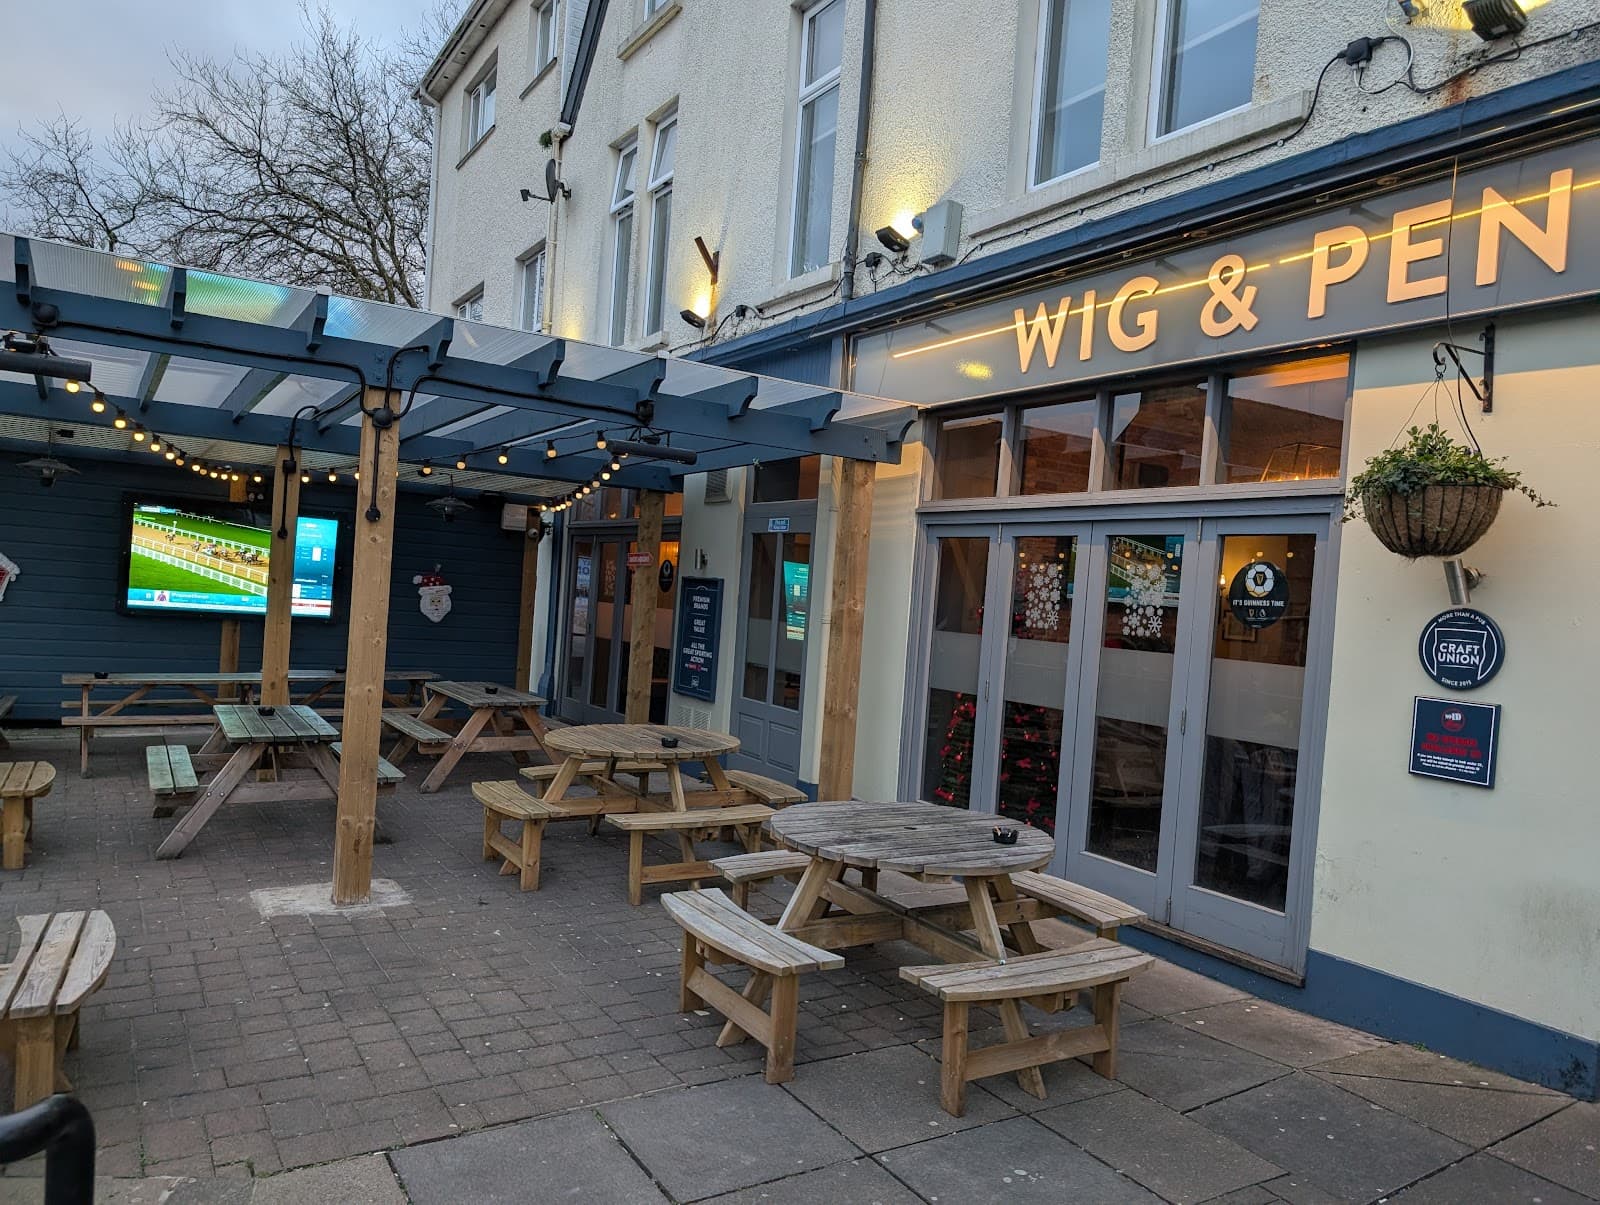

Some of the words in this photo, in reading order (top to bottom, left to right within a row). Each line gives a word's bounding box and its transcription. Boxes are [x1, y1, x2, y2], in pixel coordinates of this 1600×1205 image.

[1013, 275, 1161, 374] WIG
[1199, 253, 1259, 338] &
[1306, 168, 1574, 319] PEN
[1438, 612, 1454, 623] MORE
[1475, 616, 1486, 625] PUB
[1439, 643, 1480, 655] CRAFT
[1437, 652, 1480, 665] UNION
[1441, 677, 1458, 686] SINCE
